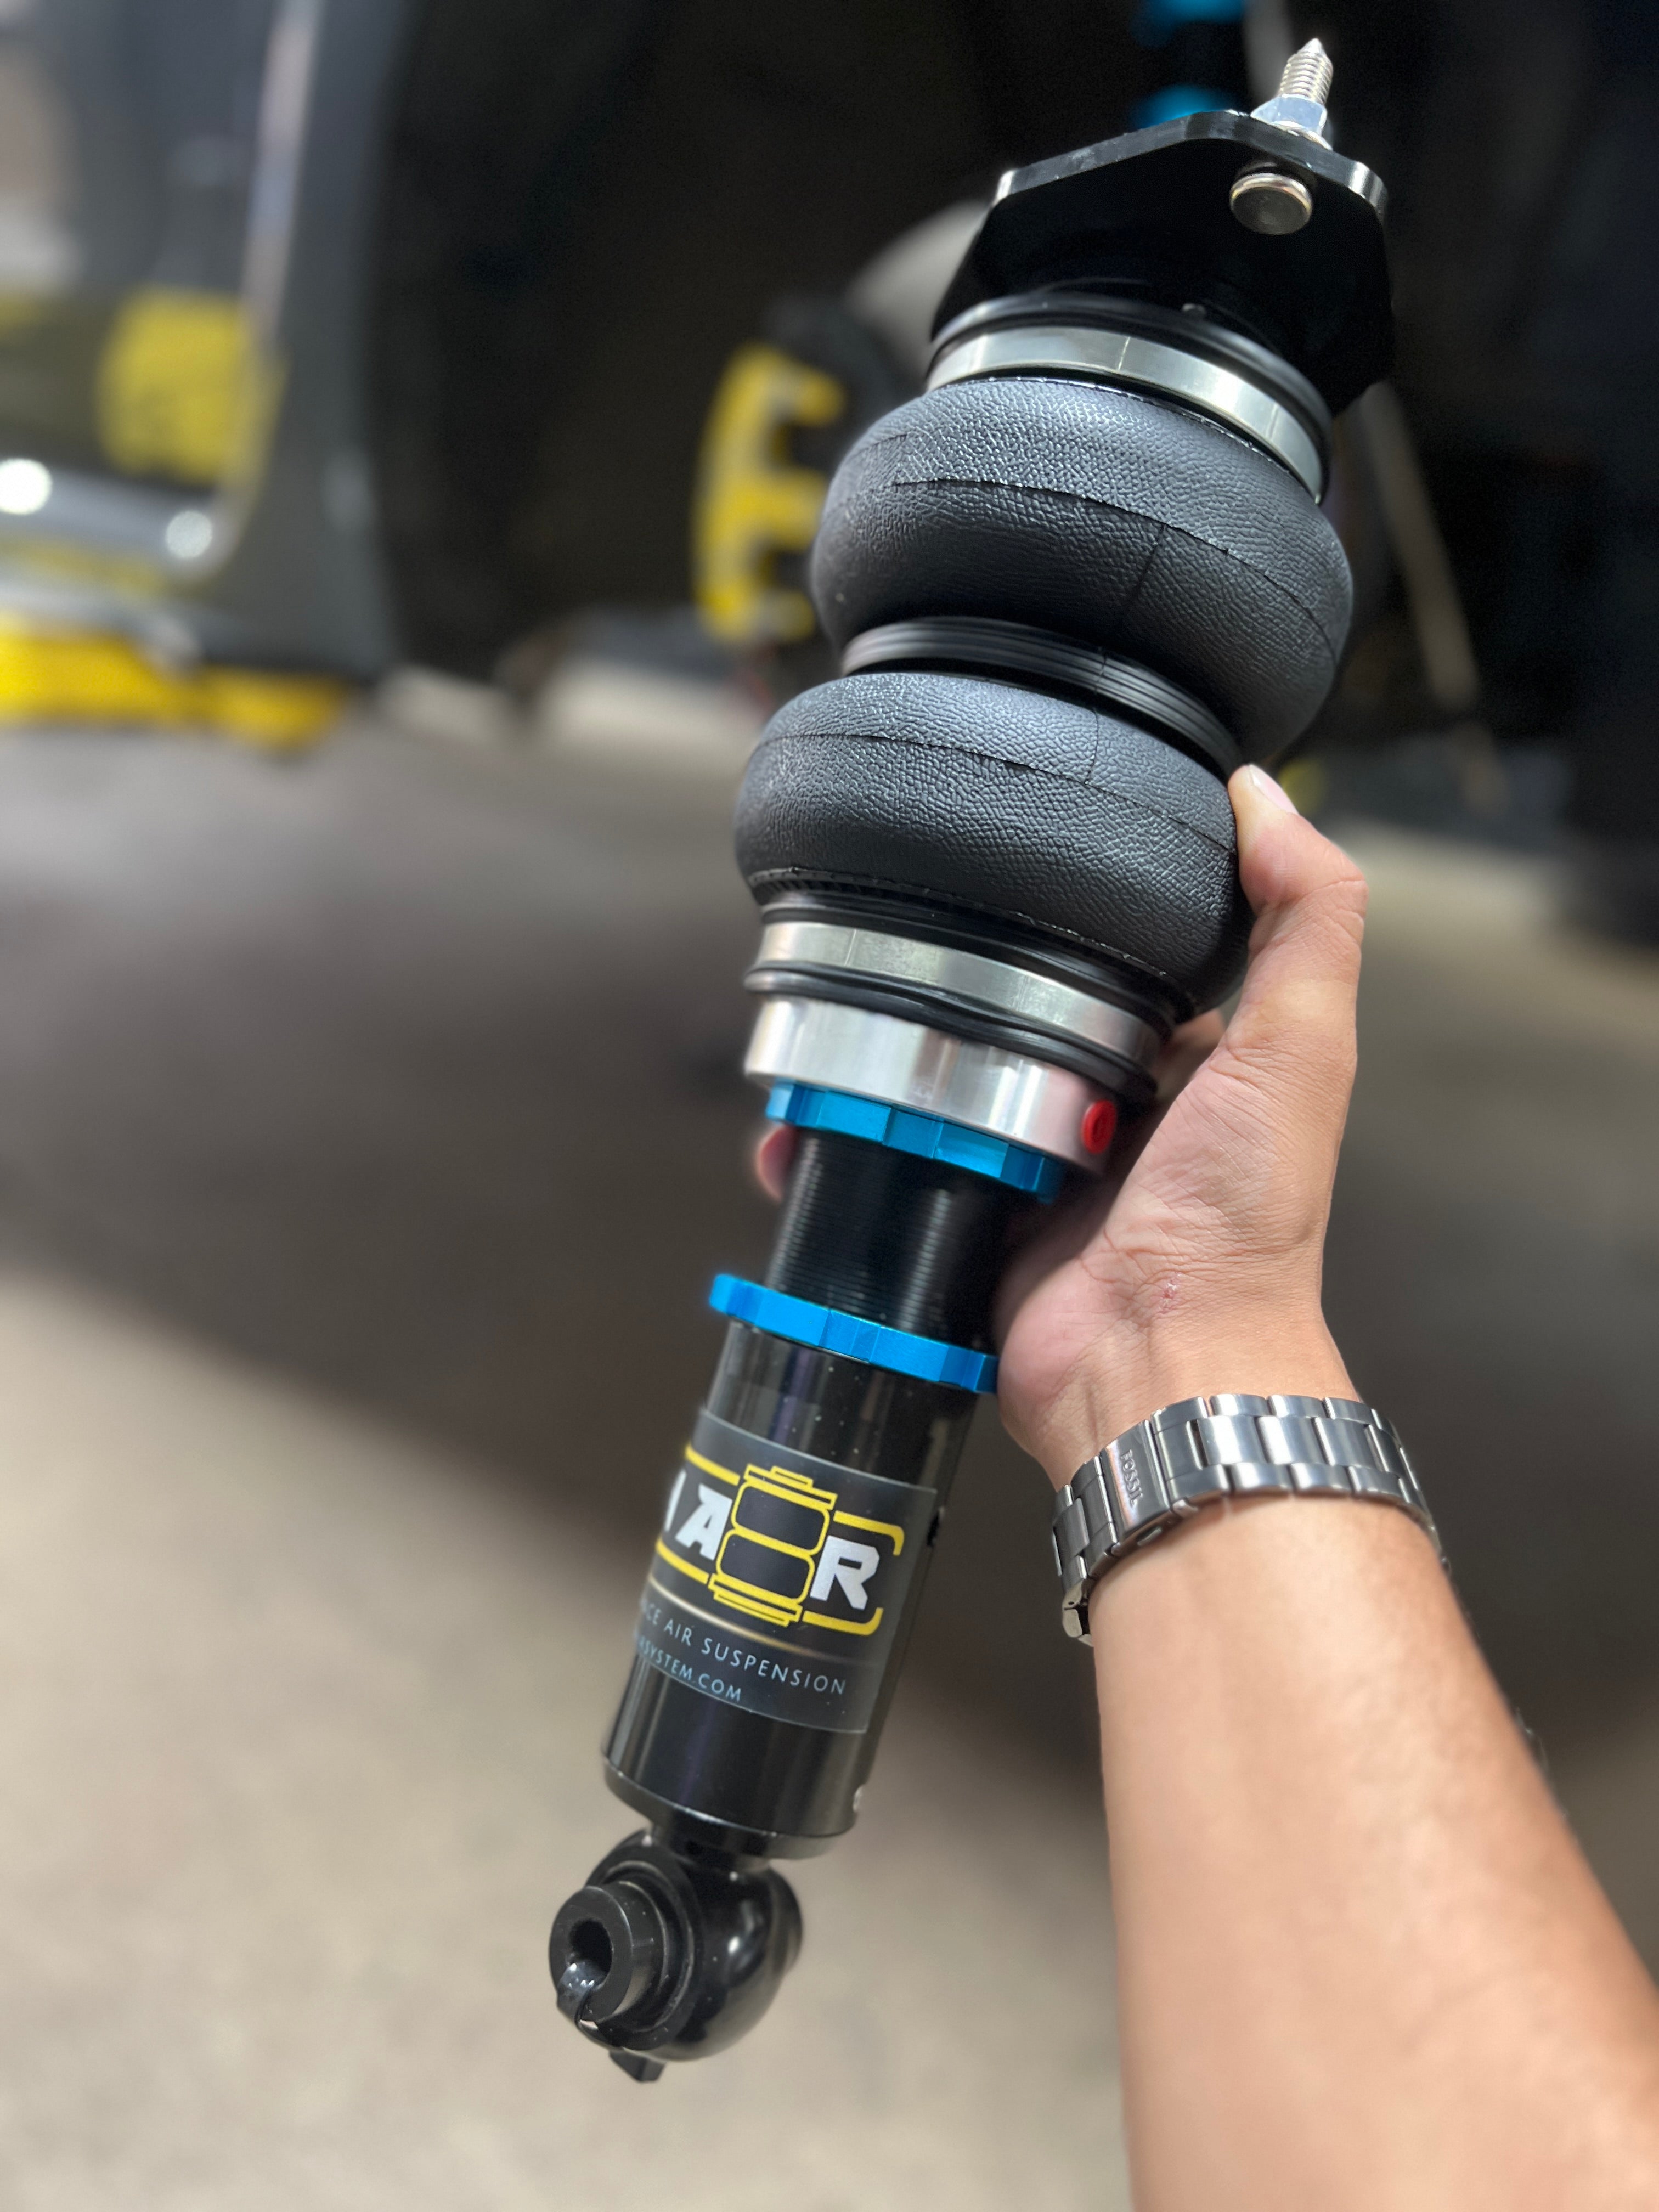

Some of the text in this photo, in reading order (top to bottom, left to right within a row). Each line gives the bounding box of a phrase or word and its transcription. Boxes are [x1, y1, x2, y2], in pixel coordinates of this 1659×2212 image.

[1120, 1449, 1144, 1508] FOSSIL
[663, 1618, 692, 1646] AIR
[701, 1637, 847, 1695] SUSPENSION
